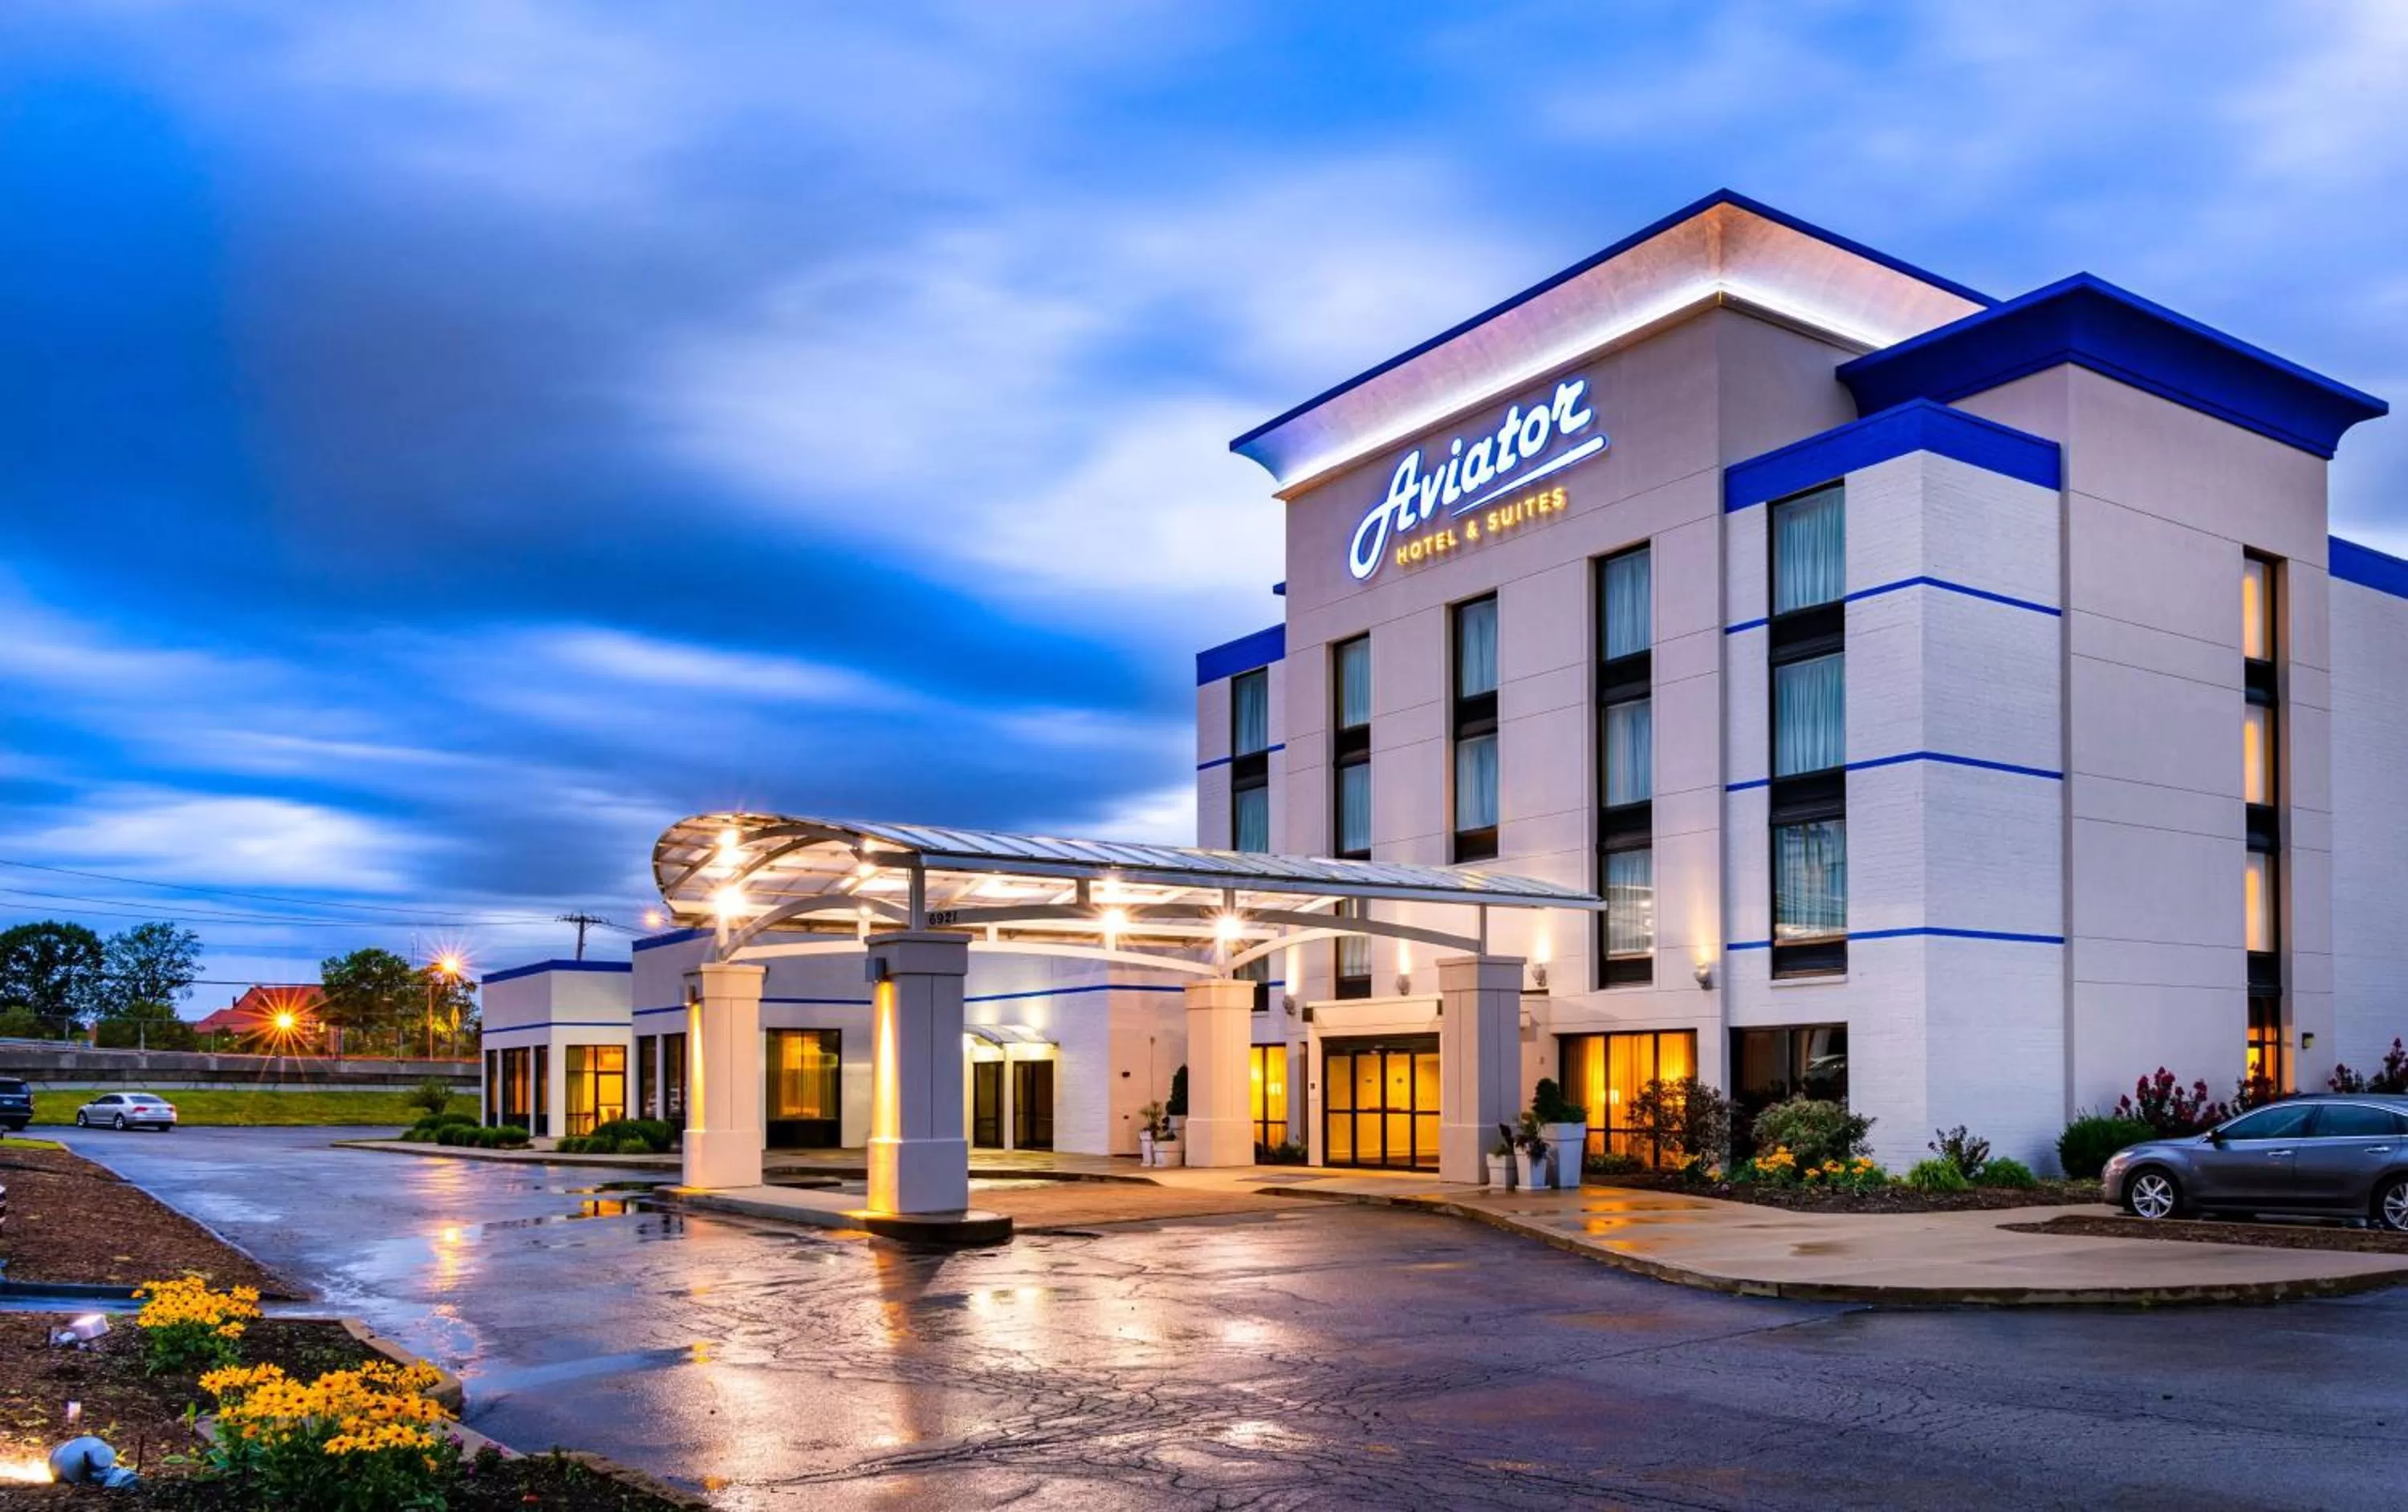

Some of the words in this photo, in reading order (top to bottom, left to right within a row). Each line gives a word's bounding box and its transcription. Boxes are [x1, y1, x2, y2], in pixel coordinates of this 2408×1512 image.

[1348, 379, 1593, 579] Aviator
[1396, 529, 1458, 564] HOTEL
[1466, 520, 1480, 539] &
[1487, 487, 1567, 532] SUITES
[929, 910, 958, 925] 6921
